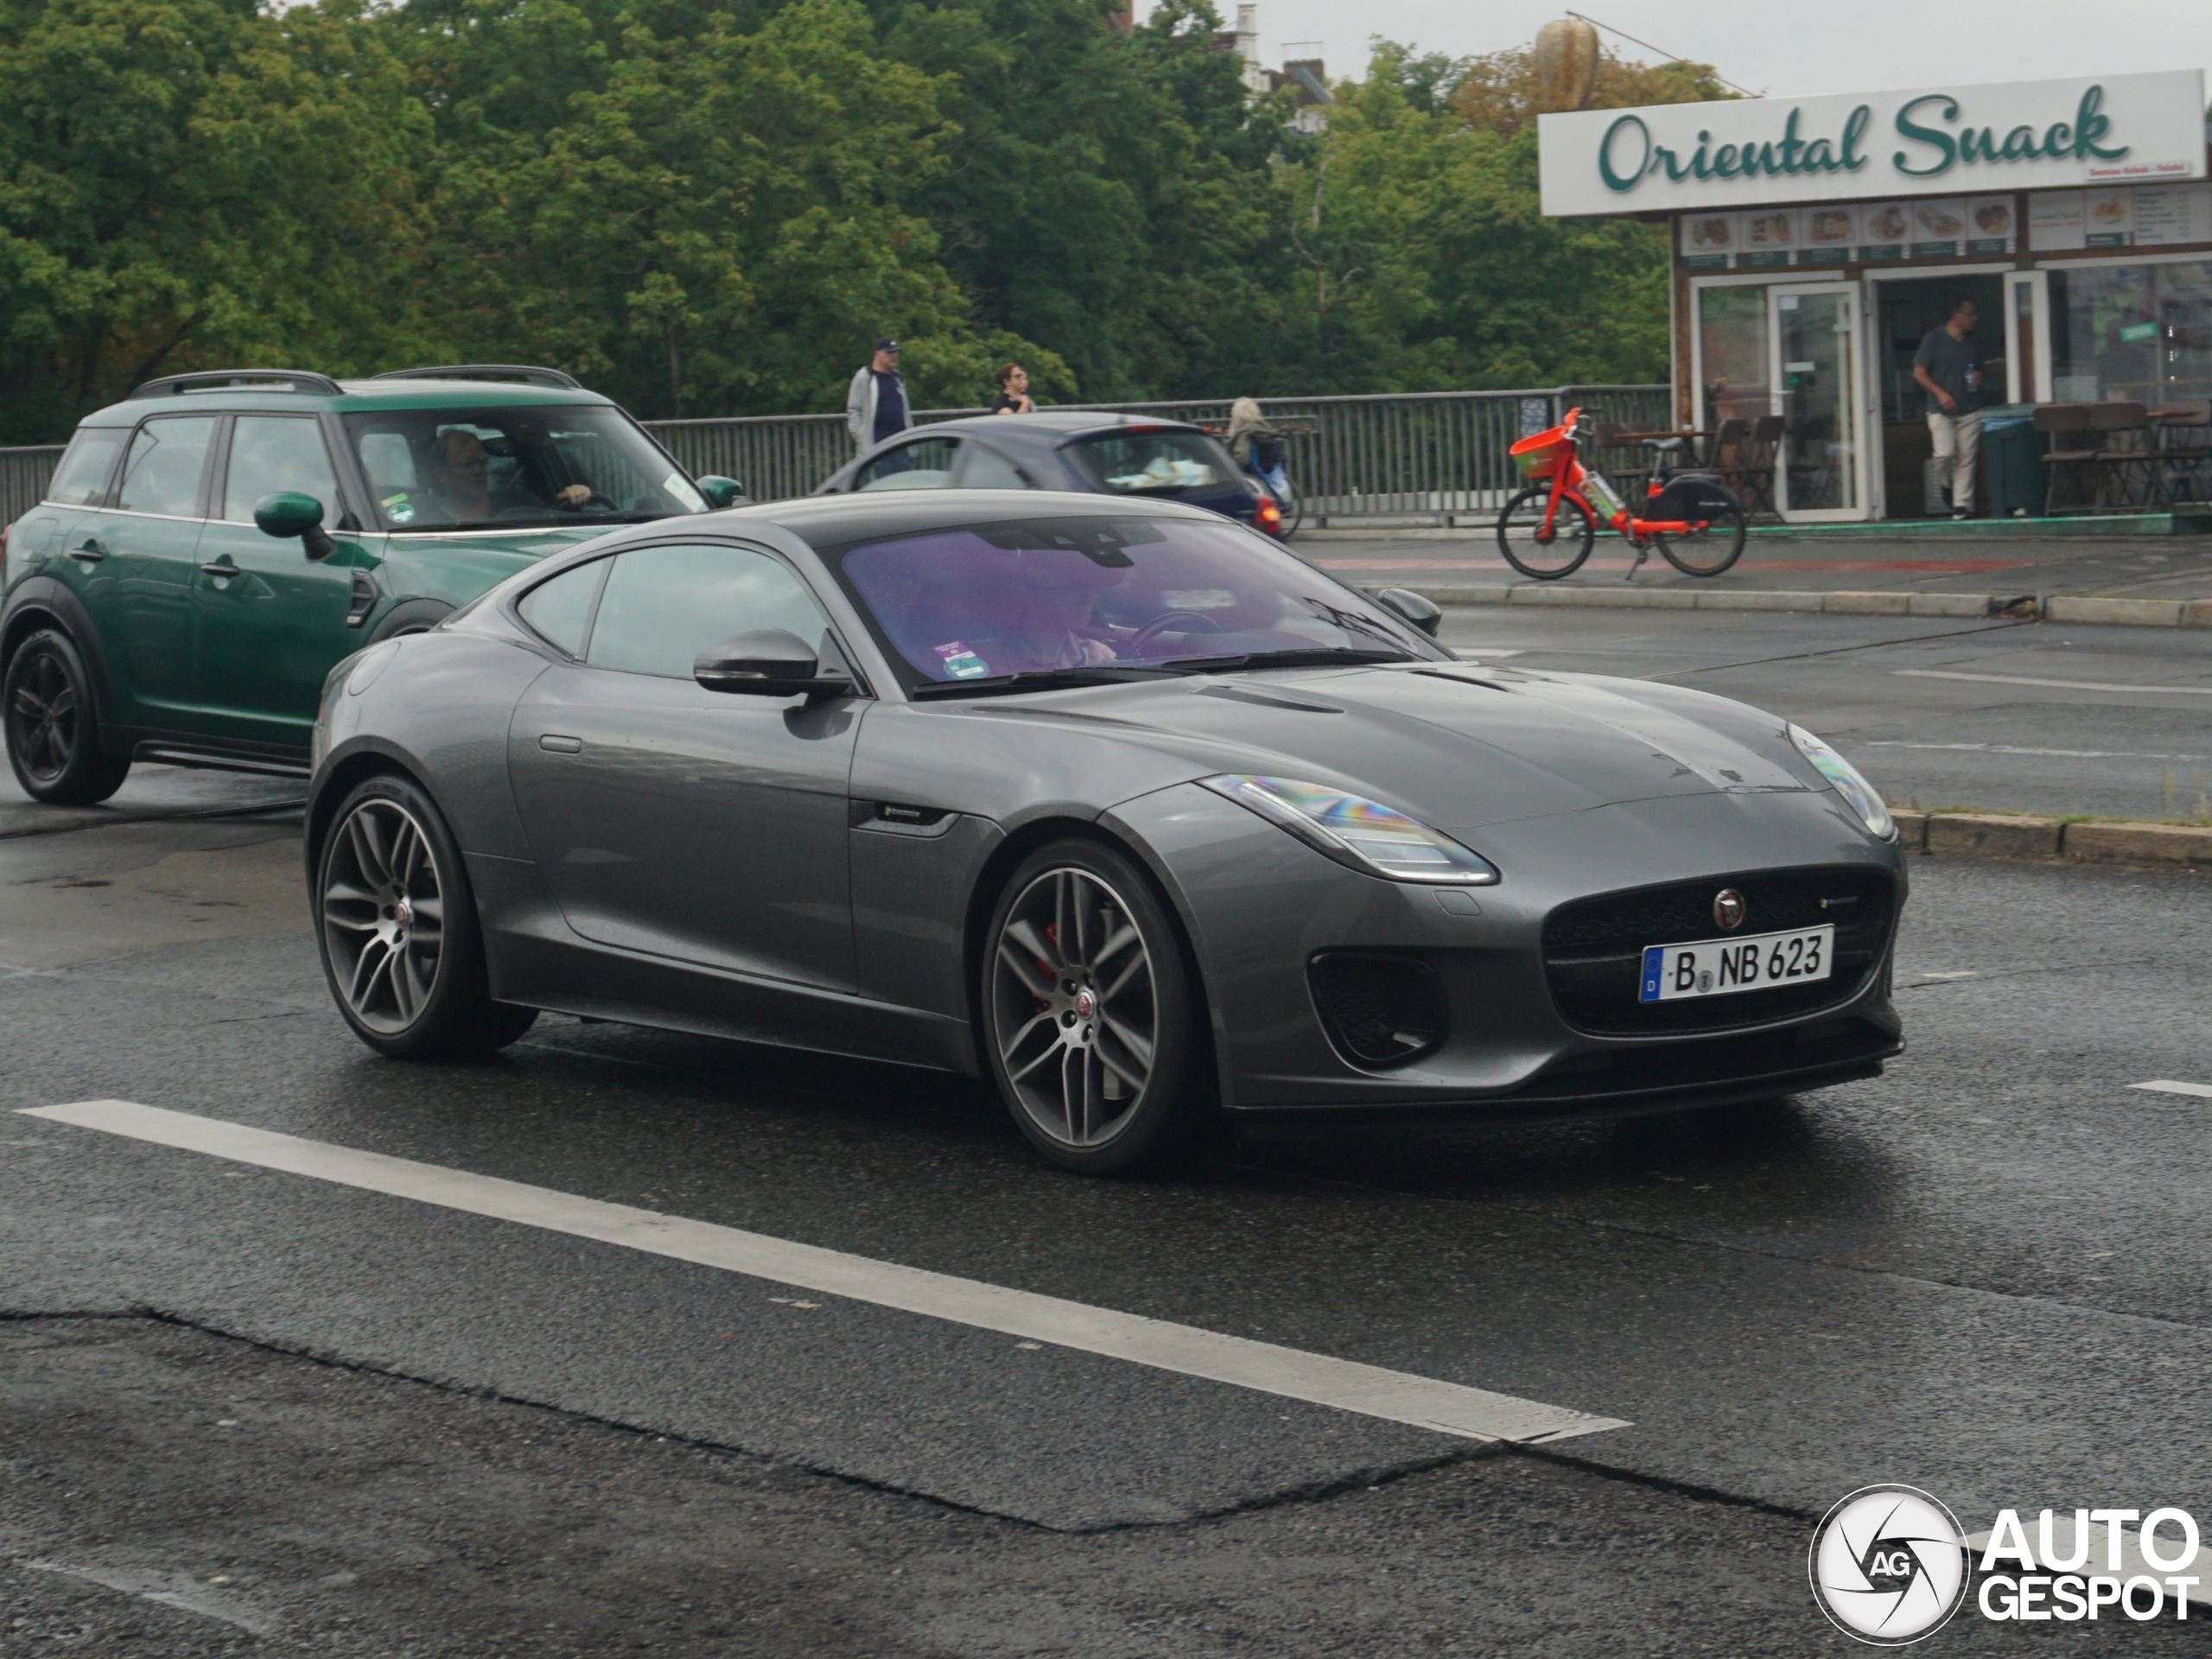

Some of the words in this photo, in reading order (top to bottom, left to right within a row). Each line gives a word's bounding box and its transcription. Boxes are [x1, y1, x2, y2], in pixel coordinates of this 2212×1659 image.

[1599, 105, 1871, 192] Oriental
[1892, 85, 2130, 175] Snack
[1647, 980, 1656, 992] D
[1675, 951, 1696, 991] B
[1719, 944, 1759, 987] NB
[1768, 934, 1822, 980] 623
